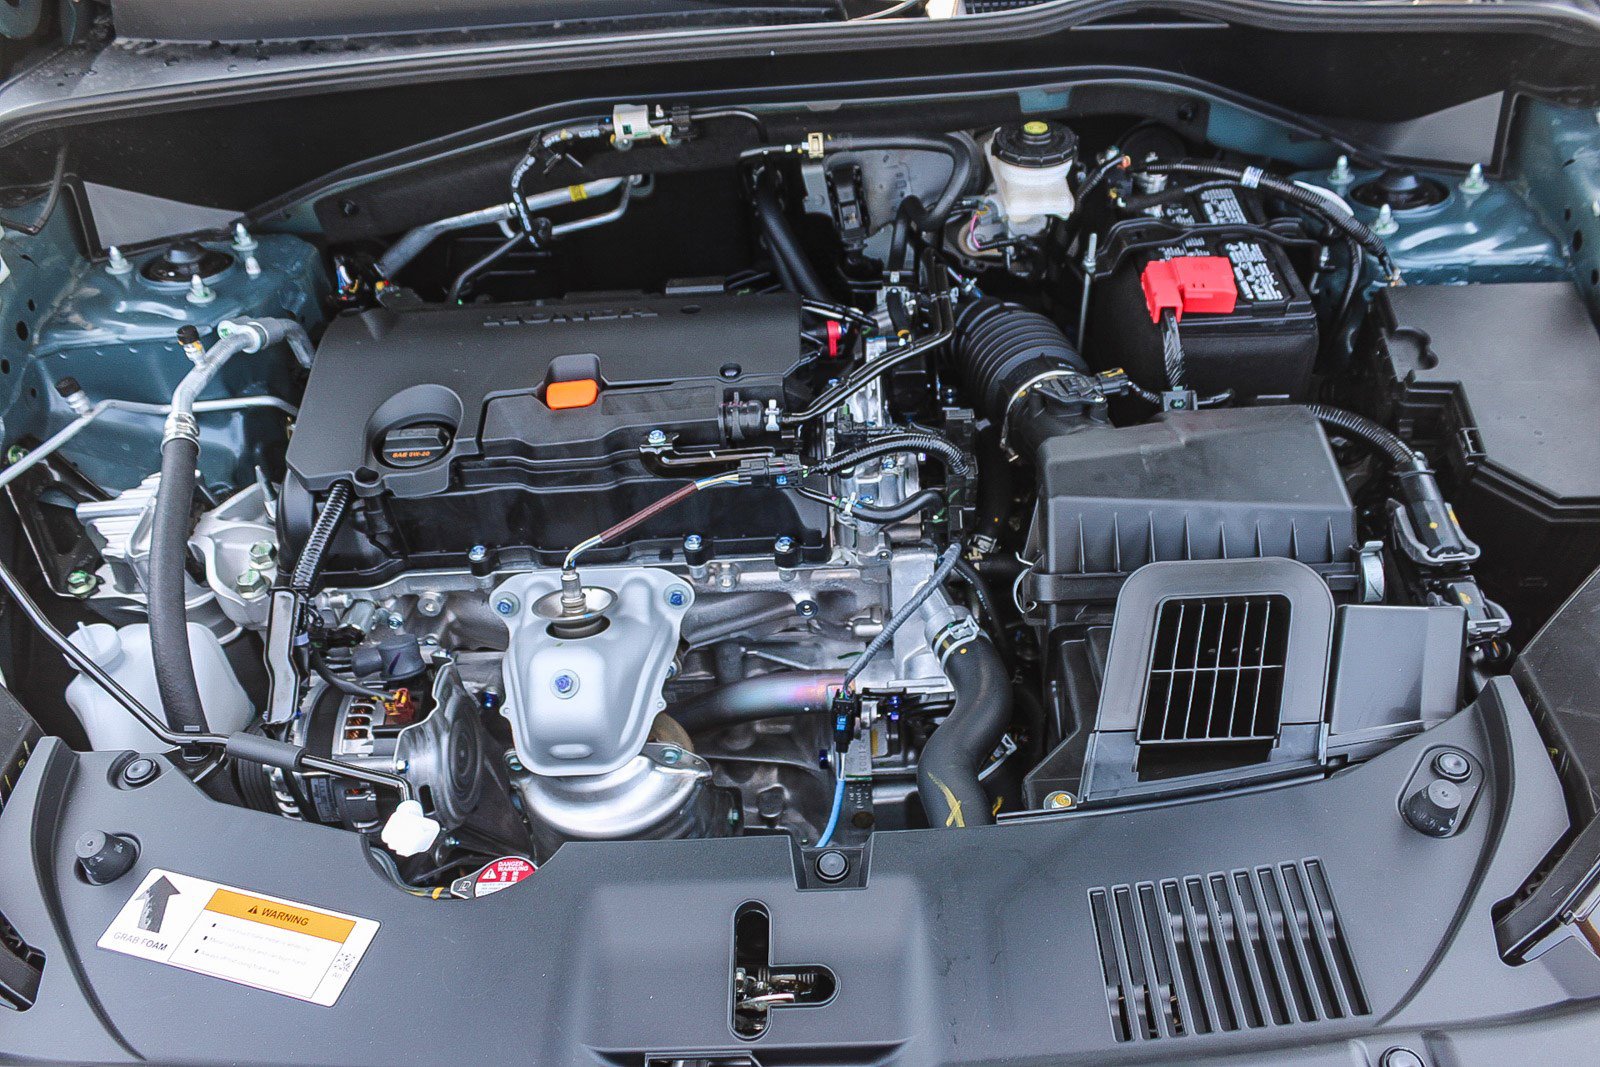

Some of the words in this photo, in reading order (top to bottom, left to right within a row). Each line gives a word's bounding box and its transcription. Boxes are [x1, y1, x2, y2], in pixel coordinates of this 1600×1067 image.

[261, 907, 309, 926] WARNING
[113, 931, 141, 945] GRAB
[140, 938, 169, 951] FOAM
